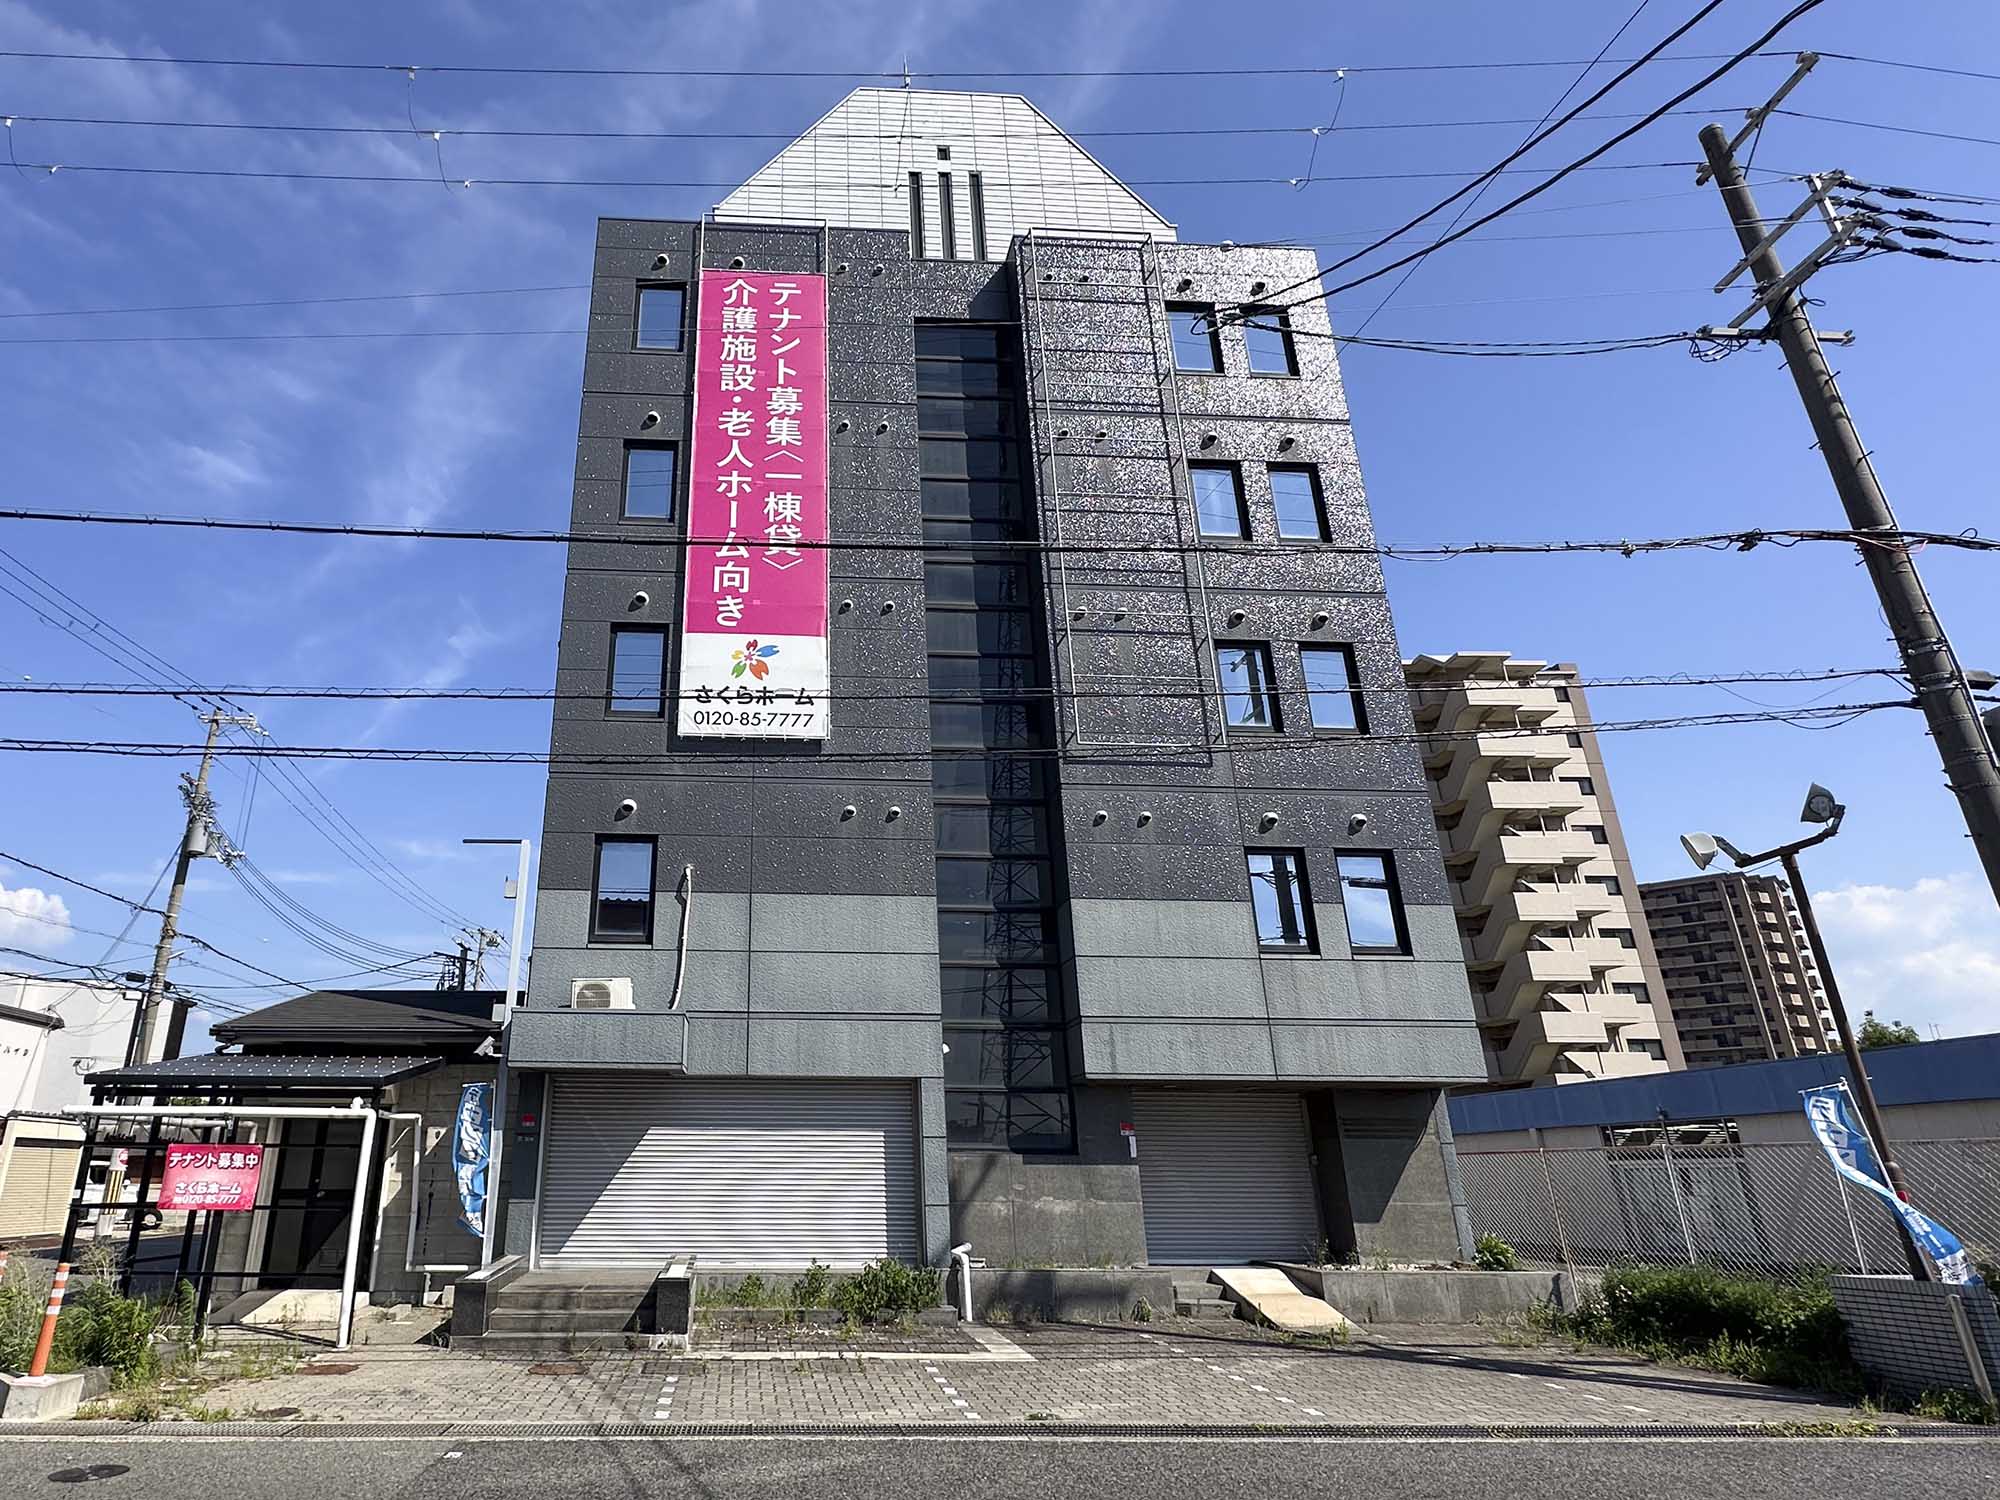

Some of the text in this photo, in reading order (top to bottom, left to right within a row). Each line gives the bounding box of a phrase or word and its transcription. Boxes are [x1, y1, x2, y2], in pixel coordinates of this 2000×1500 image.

[713, 279, 758, 627] 介護施設・老人ホーム向き
[695, 685, 814, 706] さくらホーム
[693, 711, 814, 728] 0120-85-7777
[169, 1152, 259, 1169] テナント募集中
[175, 1182, 242, 1195] さくらホーム
